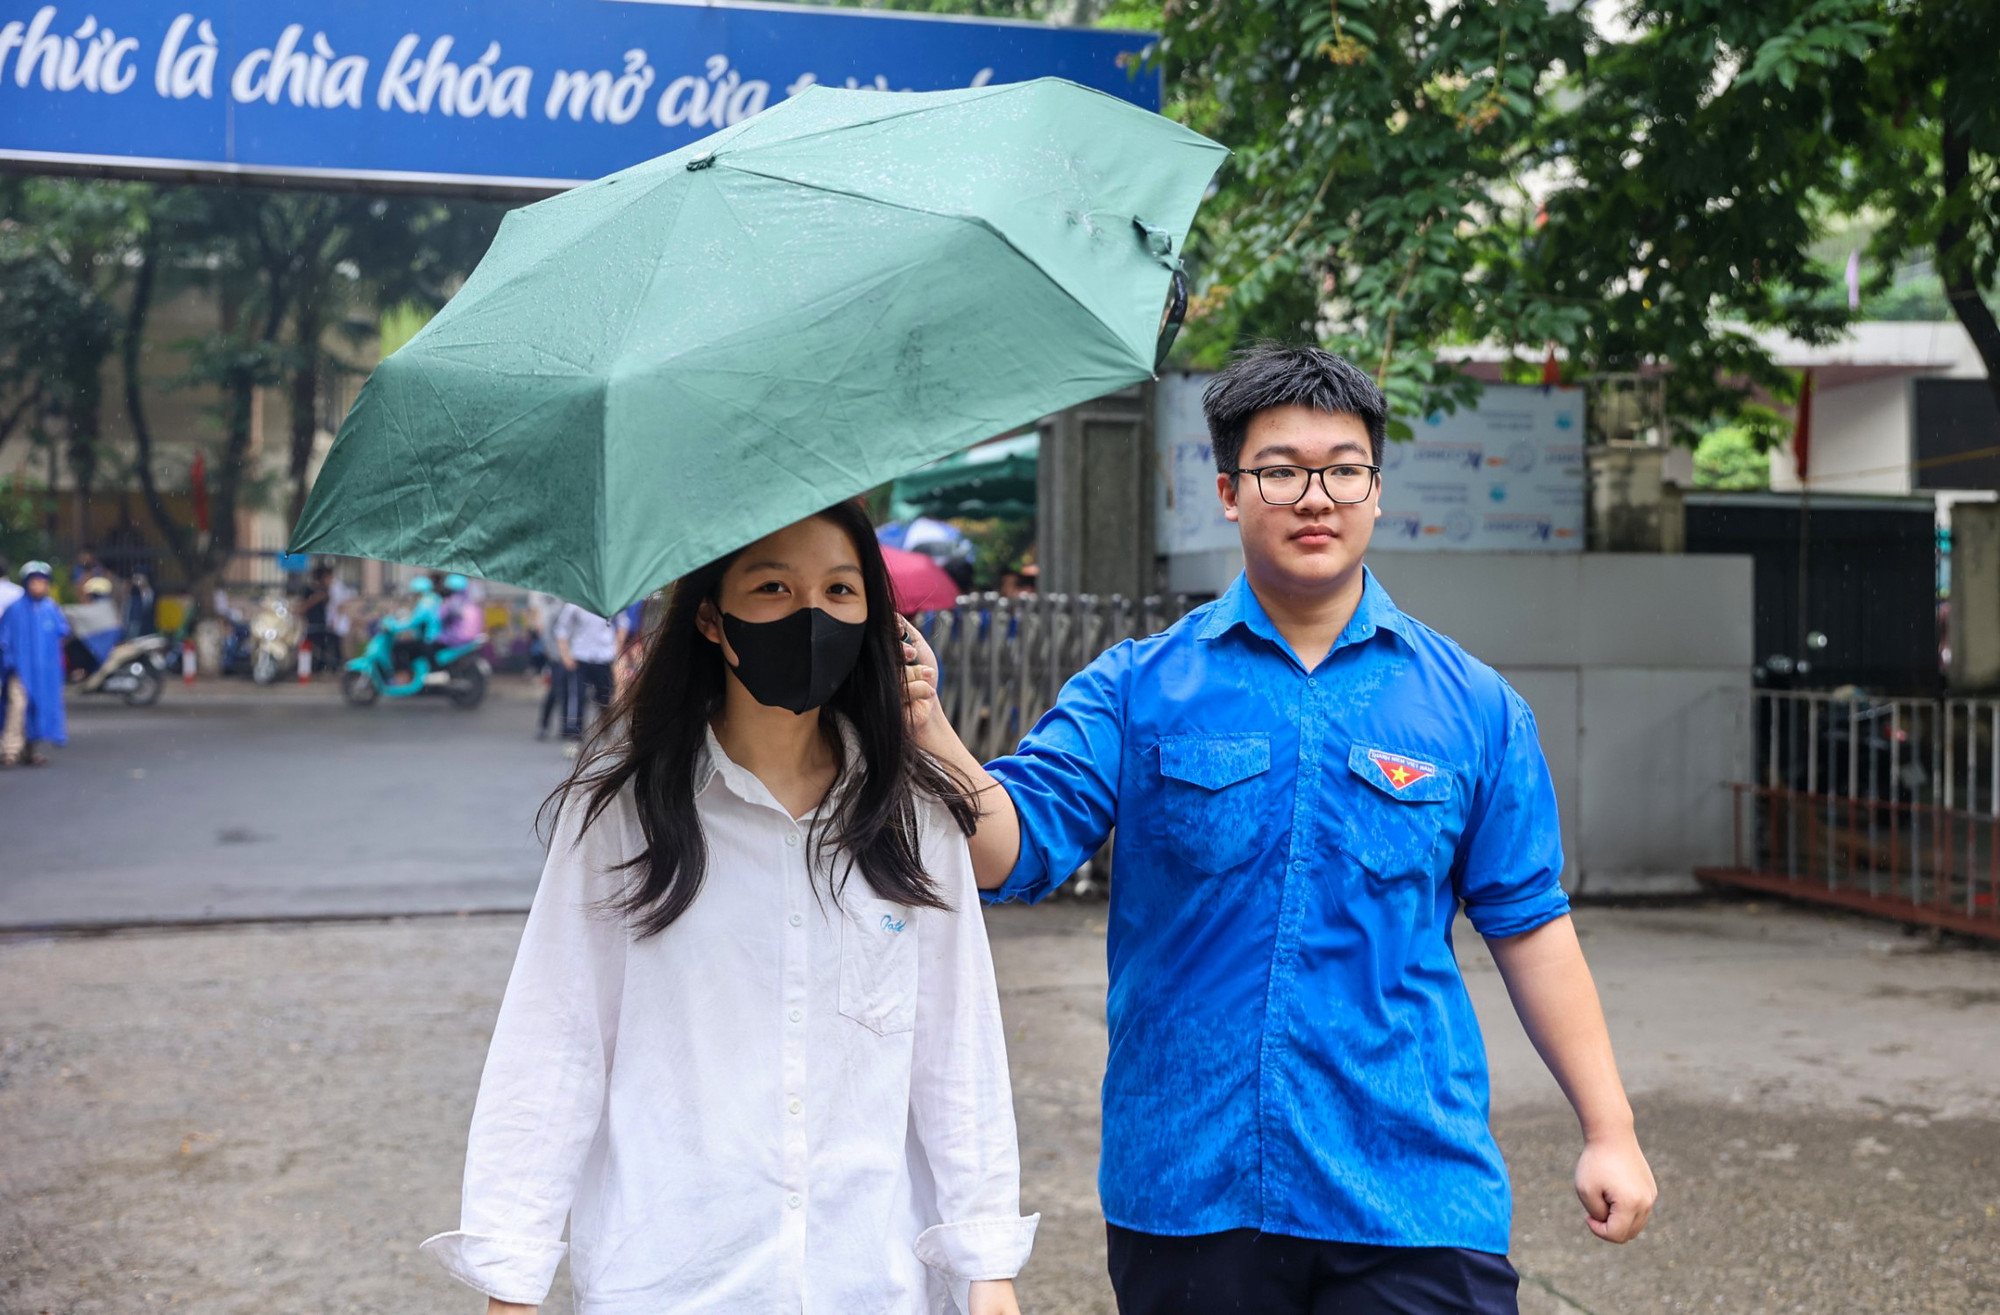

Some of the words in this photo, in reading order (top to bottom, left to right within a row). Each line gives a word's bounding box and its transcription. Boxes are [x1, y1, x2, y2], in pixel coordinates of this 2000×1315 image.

[154, 13, 219, 99] là
[231, 23, 369, 110] chìa
[377, 33, 533, 119] khóa
[544, 48, 655, 125] mở
[656, 54, 770, 129] cửa
